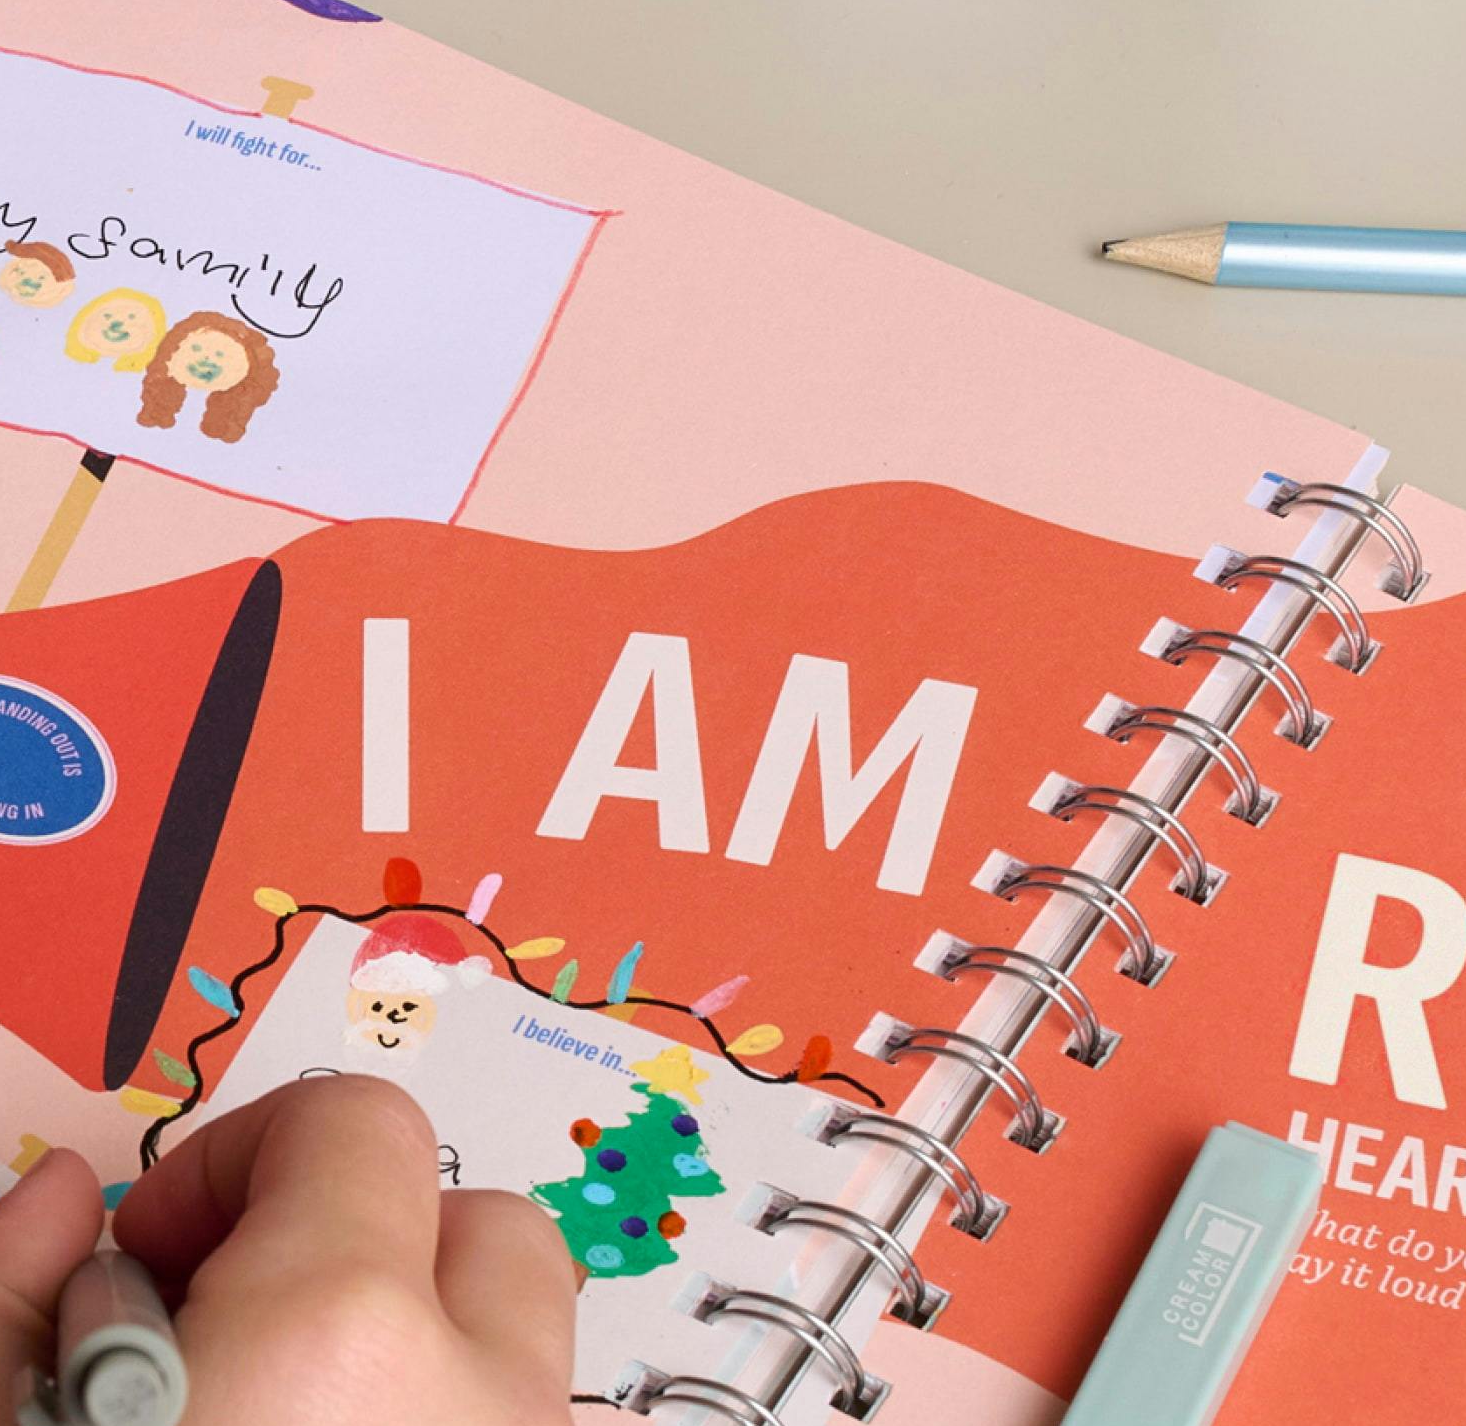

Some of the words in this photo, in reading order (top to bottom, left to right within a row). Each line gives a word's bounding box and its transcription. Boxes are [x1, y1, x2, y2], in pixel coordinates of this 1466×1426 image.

[184, 119, 196, 137] I
[196, 124, 232, 146] will
[231, 131, 278, 158] fight
[278, 143, 322, 171] for...
[50, 732, 81, 762] OUT
[61, 761, 83, 778] IS
[361, 616, 410, 833] I
[534, 629, 979, 897] AM
[24, 802, 46, 820] IN
[512, 1014, 526, 1034] I
[523, 1018, 599, 1061] believe
[599, 1044, 638, 1078] in...
[1312, 1208, 1384, 1250] hat
[1387, 1228, 1435, 1263] do
[1162, 1248, 1214, 1324] CREAM
[1181, 1255, 1232, 1332] COLOR
[1288, 1252, 1335, 1285] ay
[1339, 1256, 1375, 1289] it
